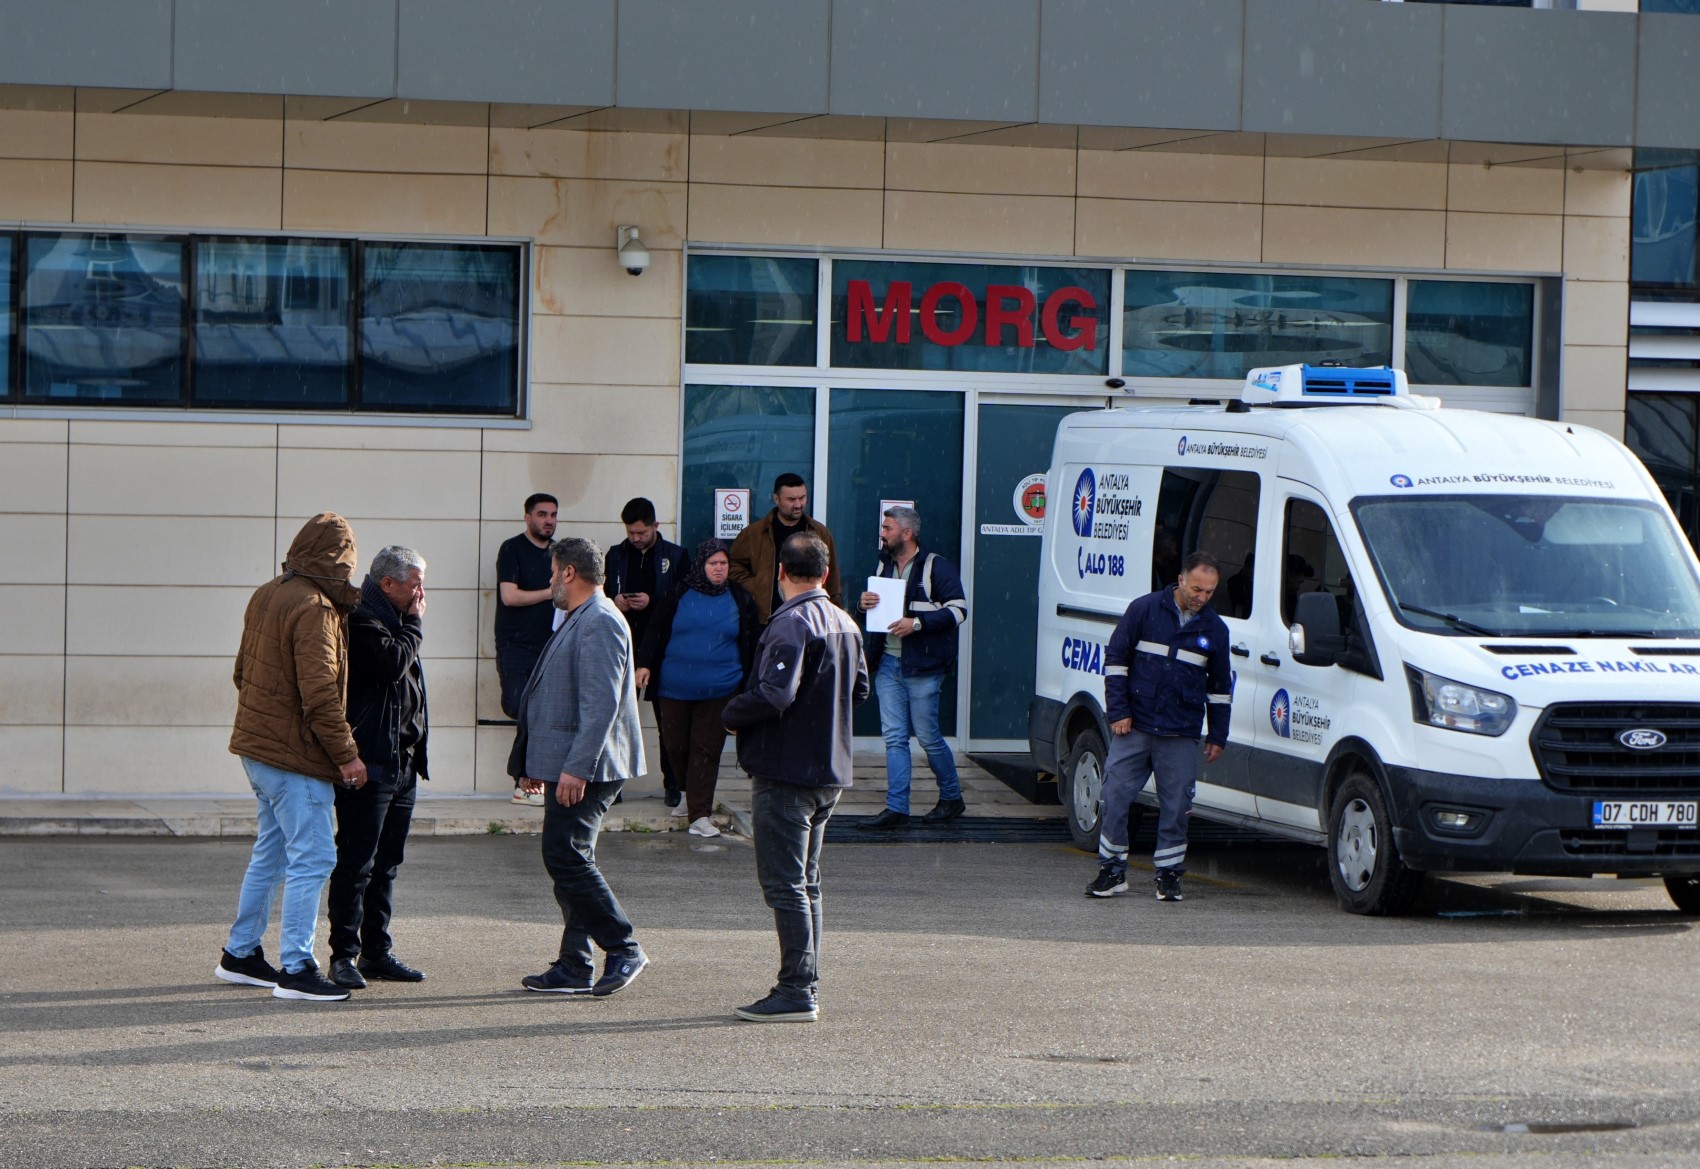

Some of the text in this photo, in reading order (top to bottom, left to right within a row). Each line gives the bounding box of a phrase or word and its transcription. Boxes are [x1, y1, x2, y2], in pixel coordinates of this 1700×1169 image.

[847, 280, 1097, 352] MORG
[1186, 442, 1268, 459] ANTALYA BÜYÜKŞEHİR BELEDİYESİ
[1098, 474, 1129, 491] ANTALYA
[1417, 473, 1616, 490] ANTALYA BÜYÜKŞEHİR BELEDİYESİ
[1096, 493, 1142, 519] BÜYÜKŞEHİR
[722, 513, 743, 521] SİGARA
[720, 522, 744, 532] İÇİLMEZ
[1094, 520, 1129, 541] BELEDİYESİ
[1085, 553, 1125, 577] ALO 188
[1062, 637, 1106, 676] CENA
[1501, 659, 1700, 681] CENAZE NAKİL AR
[1293, 696, 1319, 710] ANTALYA
[1292, 710, 1331, 730] BÜYÜKŞEHİR
[1292, 729, 1323, 746] BELEDİYESİ
[1629, 731, 1658, 746] Ford
[1603, 804, 1622, 822] 07
[1630, 804, 1658, 822] CDH
[1667, 804, 1695, 822] 780
